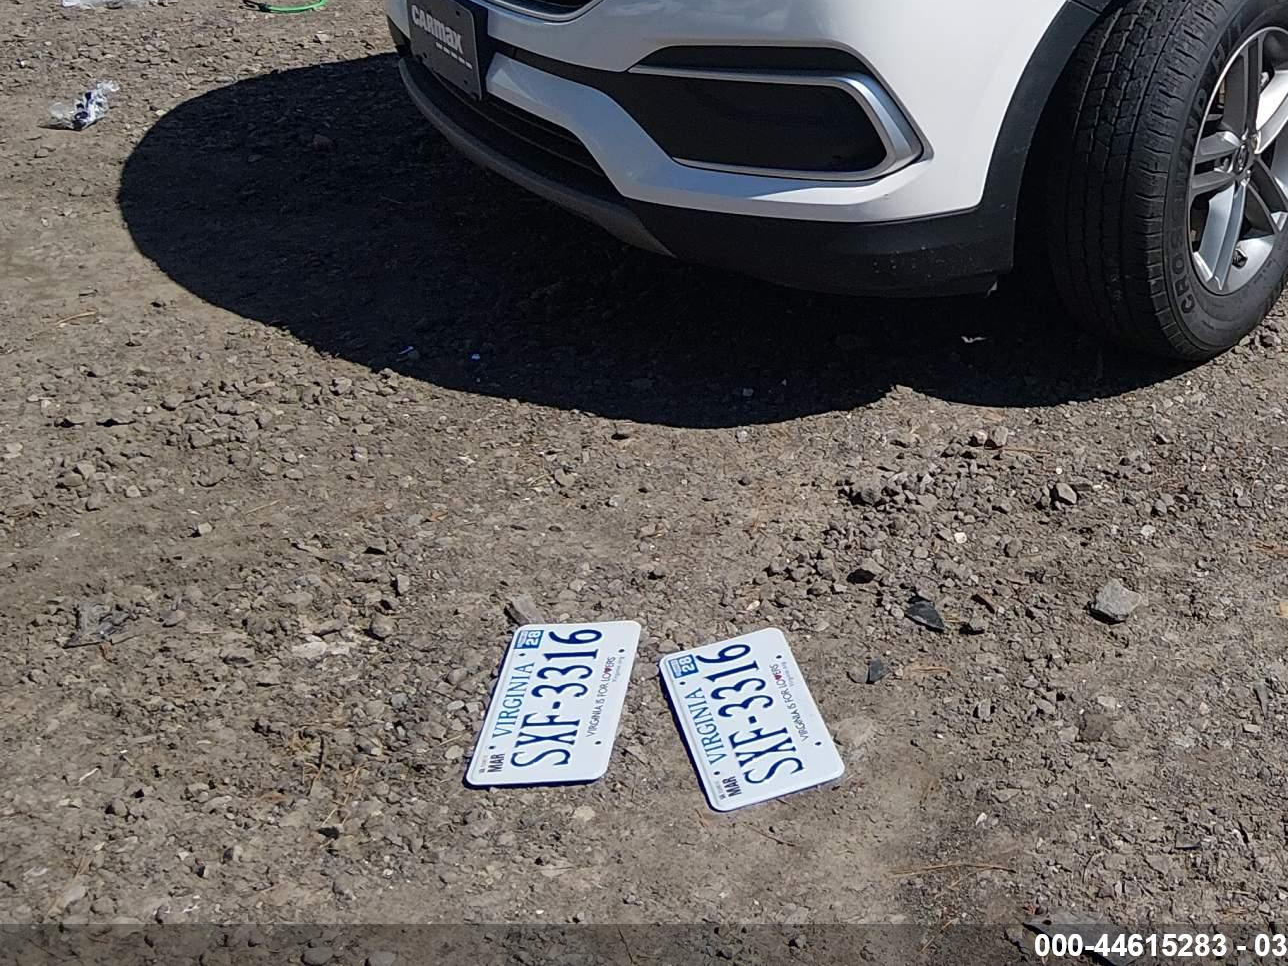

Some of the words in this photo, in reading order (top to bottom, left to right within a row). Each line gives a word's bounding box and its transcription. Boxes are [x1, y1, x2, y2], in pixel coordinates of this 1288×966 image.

[525, 630, 542, 647] 28
[679, 656, 695, 672] 28
[492, 662, 535, 738] VIRGINIA
[510, 629, 602, 767] SXF-3316
[586, 705, 603, 738] VIRGINIA
[597, 683, 608, 697] FOR
[781, 689, 792, 703] FOR
[685, 687, 727, 765] VIRGINIA
[696, 644, 805, 784] SXF-3316
[792, 708, 809, 742] VIRGINIA
[487, 753, 505, 773] MAR
[722, 776, 741, 797] MAR
